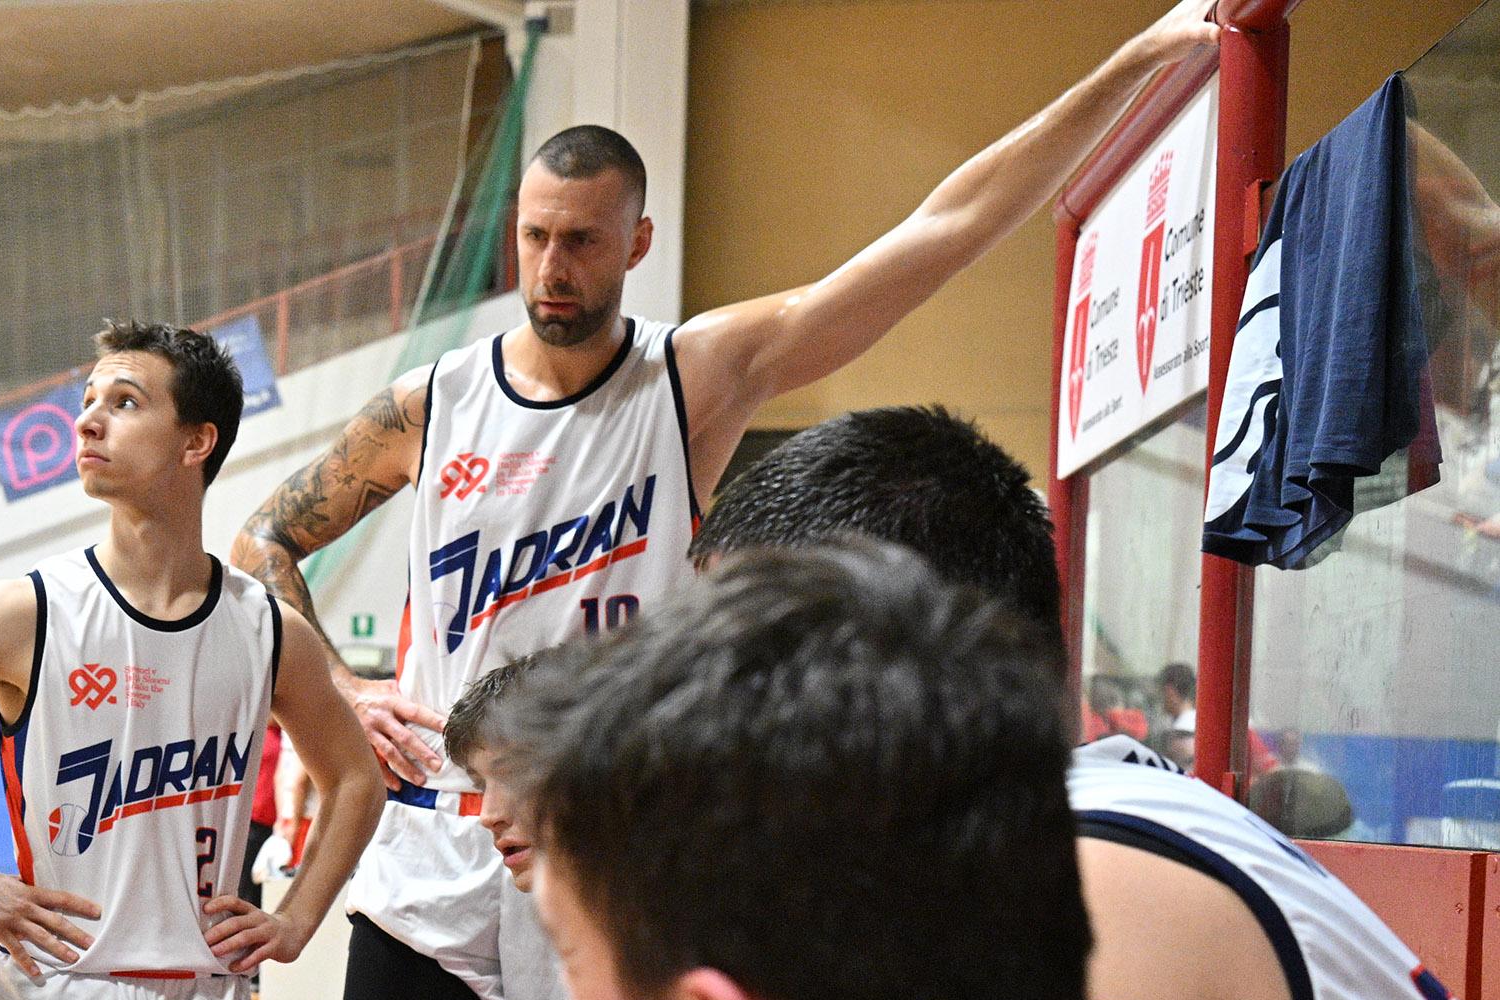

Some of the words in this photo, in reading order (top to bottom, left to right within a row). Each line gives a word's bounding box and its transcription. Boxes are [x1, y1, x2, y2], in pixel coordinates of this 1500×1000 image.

[1164, 208, 1204, 262] Comune
[1172, 268, 1204, 313] Trieste
[195, 826, 217, 898] 2
